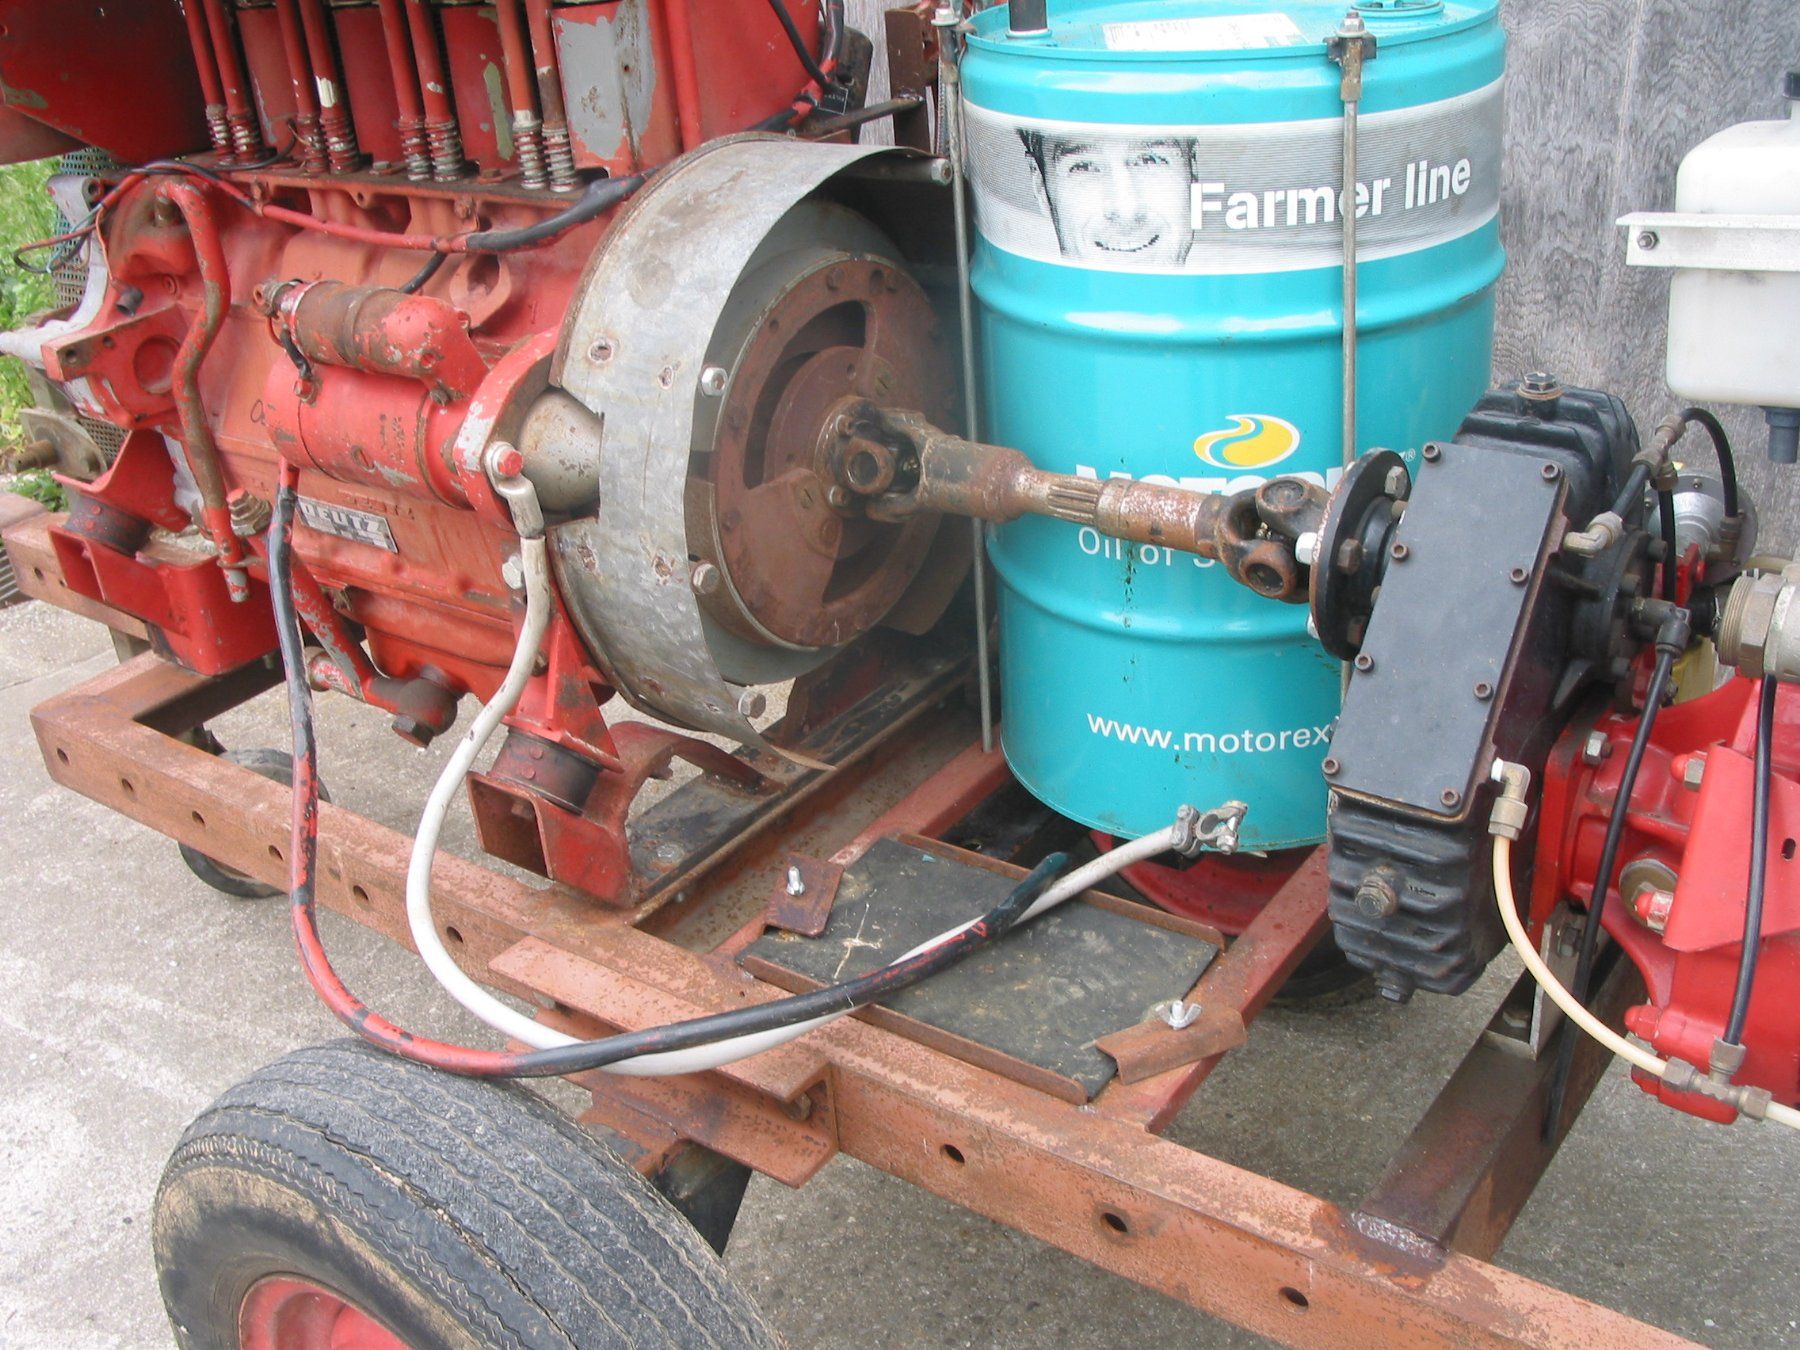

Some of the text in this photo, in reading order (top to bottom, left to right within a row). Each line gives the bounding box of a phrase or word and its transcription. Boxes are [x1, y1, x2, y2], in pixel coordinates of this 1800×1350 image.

[1190, 157, 1471, 231] Farmer line
[299, 501, 381, 532] DEUTZ
[1078, 526, 1122, 561] Oil
